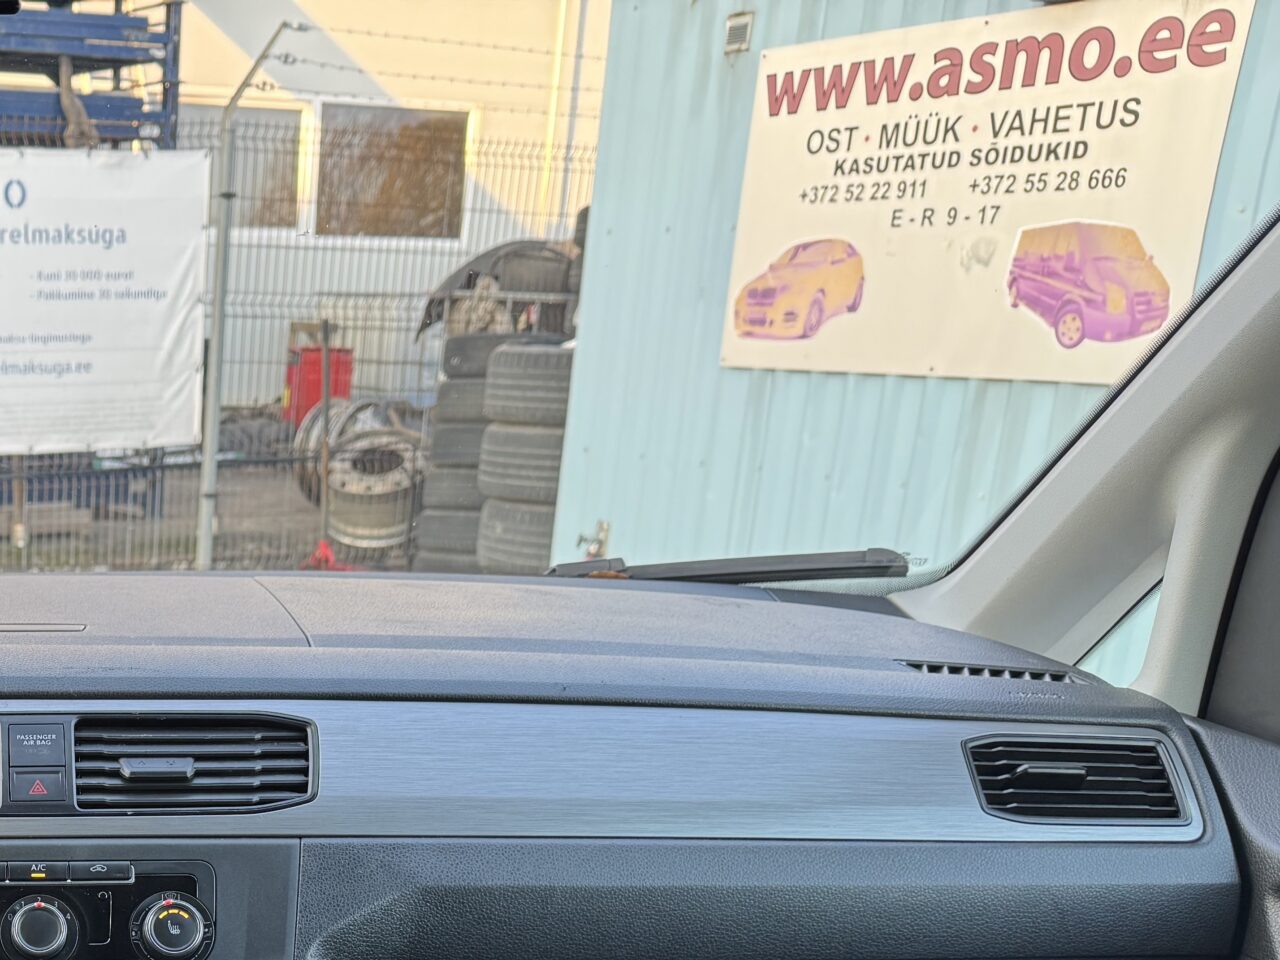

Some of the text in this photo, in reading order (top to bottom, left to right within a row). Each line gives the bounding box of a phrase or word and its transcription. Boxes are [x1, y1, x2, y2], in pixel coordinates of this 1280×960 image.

[766, 8, 1236, 117] www.asmo.ee
[806, 97, 1142, 154] OST MÜÜK VAHETUS
[833, 140, 1089, 177] KASUTATUD SÕIDUKID
[799, 178, 927, 204] +372 52 22 911
[969, 167, 1128, 196] +372 55 28 666
[890, 208, 904, 228] E
[920, 207, 936, 227] R
[946, 206, 958, 226] 9
[977, 204, 1001, 225] 17
